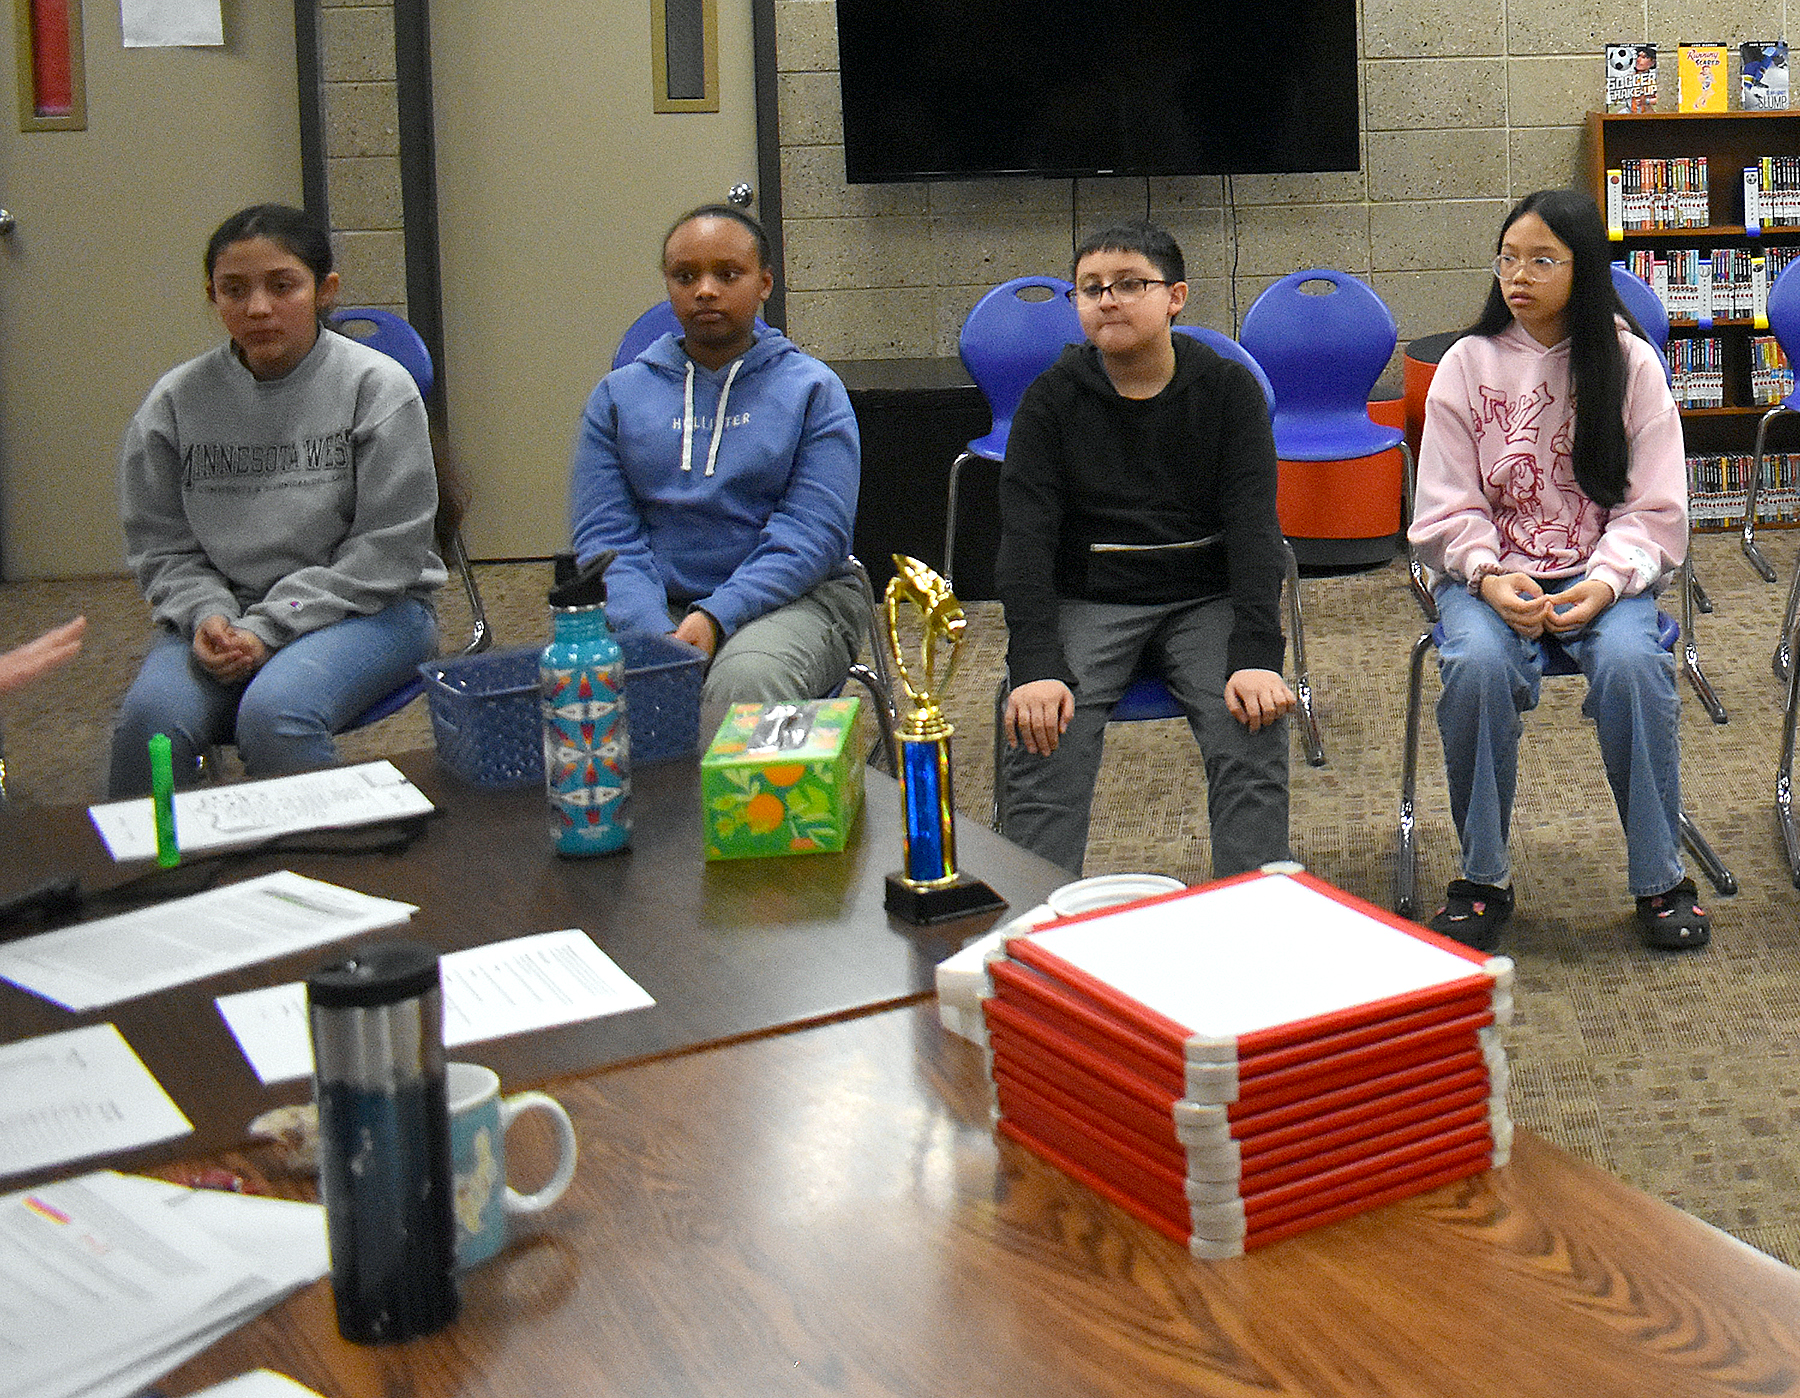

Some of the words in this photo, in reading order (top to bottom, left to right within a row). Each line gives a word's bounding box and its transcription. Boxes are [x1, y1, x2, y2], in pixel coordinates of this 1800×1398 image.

[1607, 74, 1656, 90] SOCCER
[1609, 86, 1658, 101] SHAKE-UP
[1758, 95, 1787, 109] SLUMP
[672, 412, 751, 431] HLLITER
